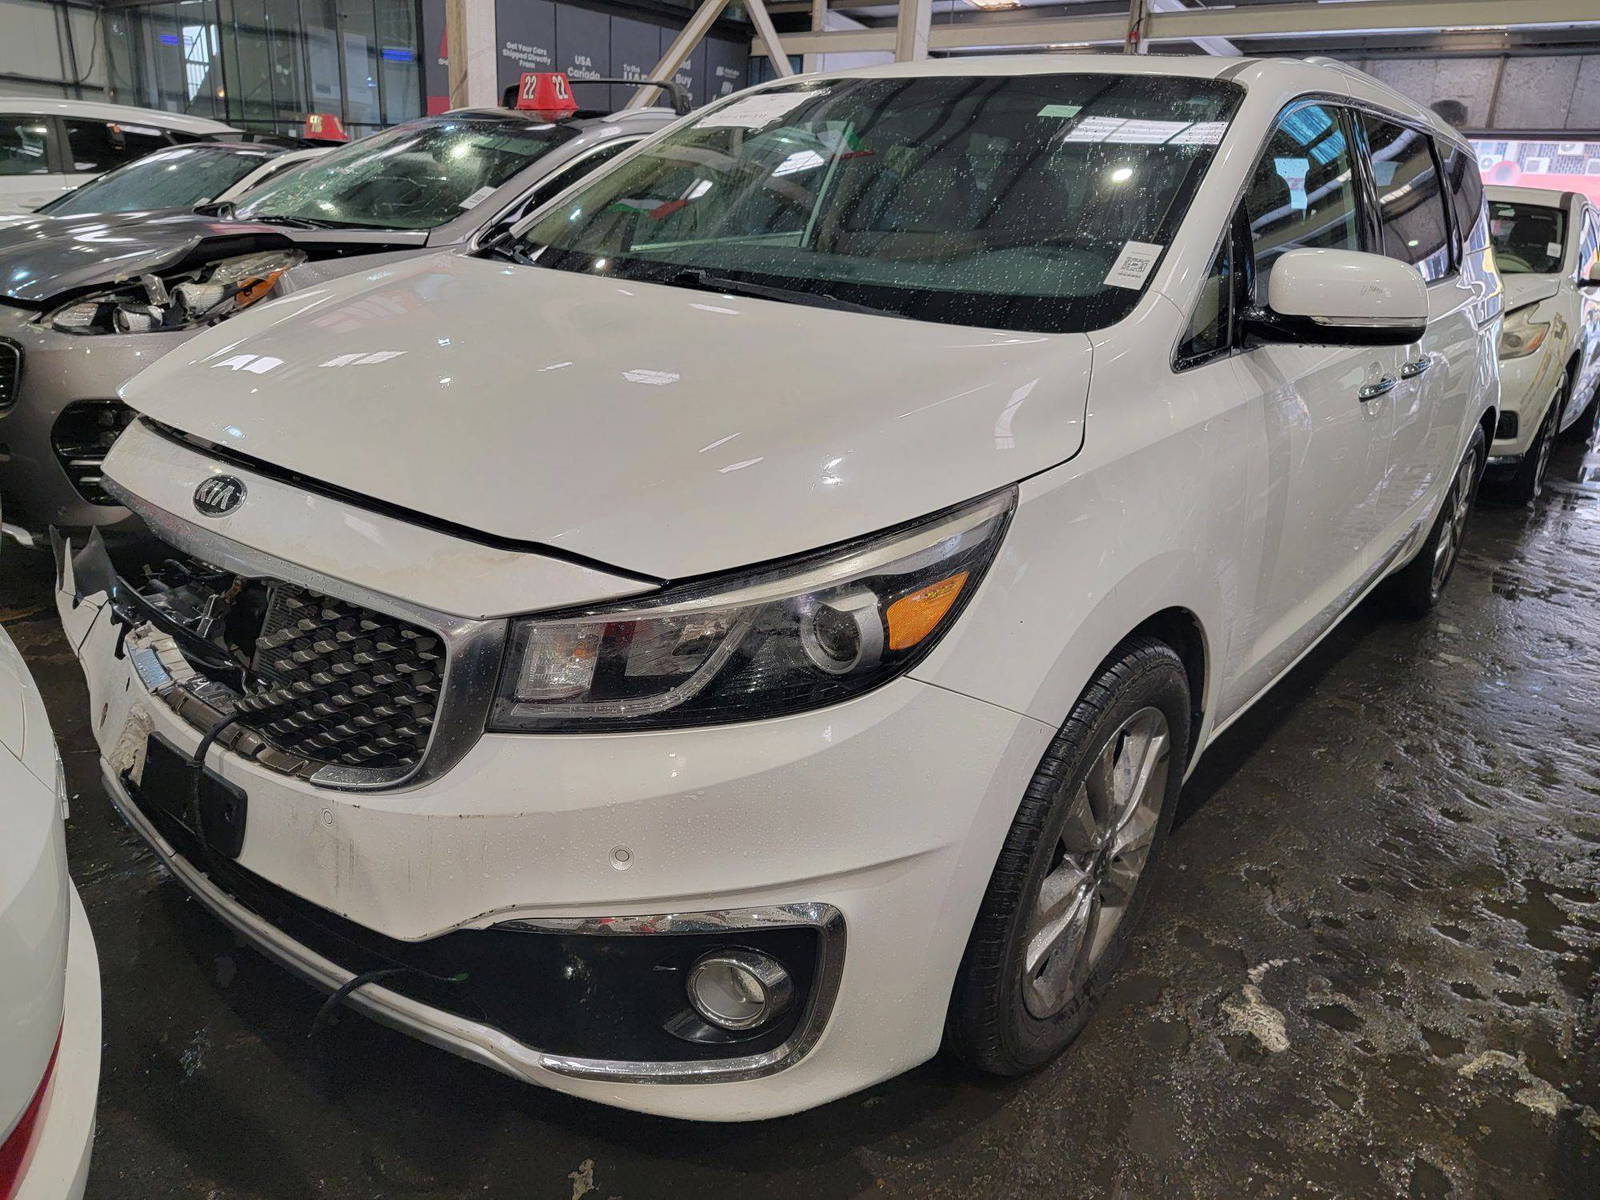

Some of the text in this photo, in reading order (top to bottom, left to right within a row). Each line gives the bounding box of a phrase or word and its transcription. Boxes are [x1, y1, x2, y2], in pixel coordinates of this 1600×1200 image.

[506, 41, 547, 56] Get Your Cars
[502, 49, 551, 65] Shipped Directly
[574, 55, 592, 67] USA
[567, 66, 601, 80] Canada
[675, 73, 692, 88] Buy
[523, 75, 568, 99] 22 22
[195, 479, 235, 510] KIA
